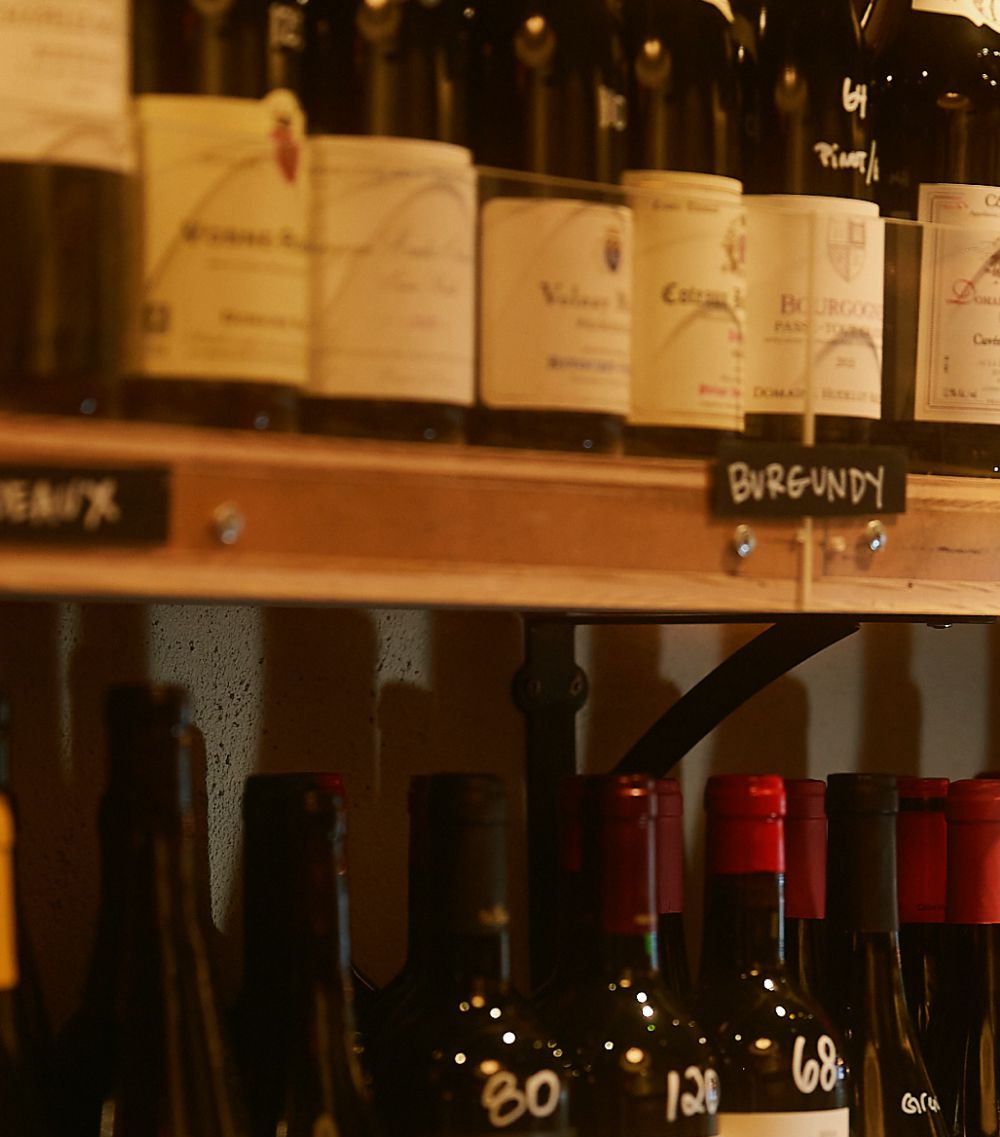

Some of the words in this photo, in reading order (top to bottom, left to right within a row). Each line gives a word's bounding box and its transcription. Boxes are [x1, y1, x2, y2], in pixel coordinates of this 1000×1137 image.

[728, 462, 885, 509] BURGUNDY
[792, 1034, 838, 1095] 68
[482, 1069, 561, 1128] 80
